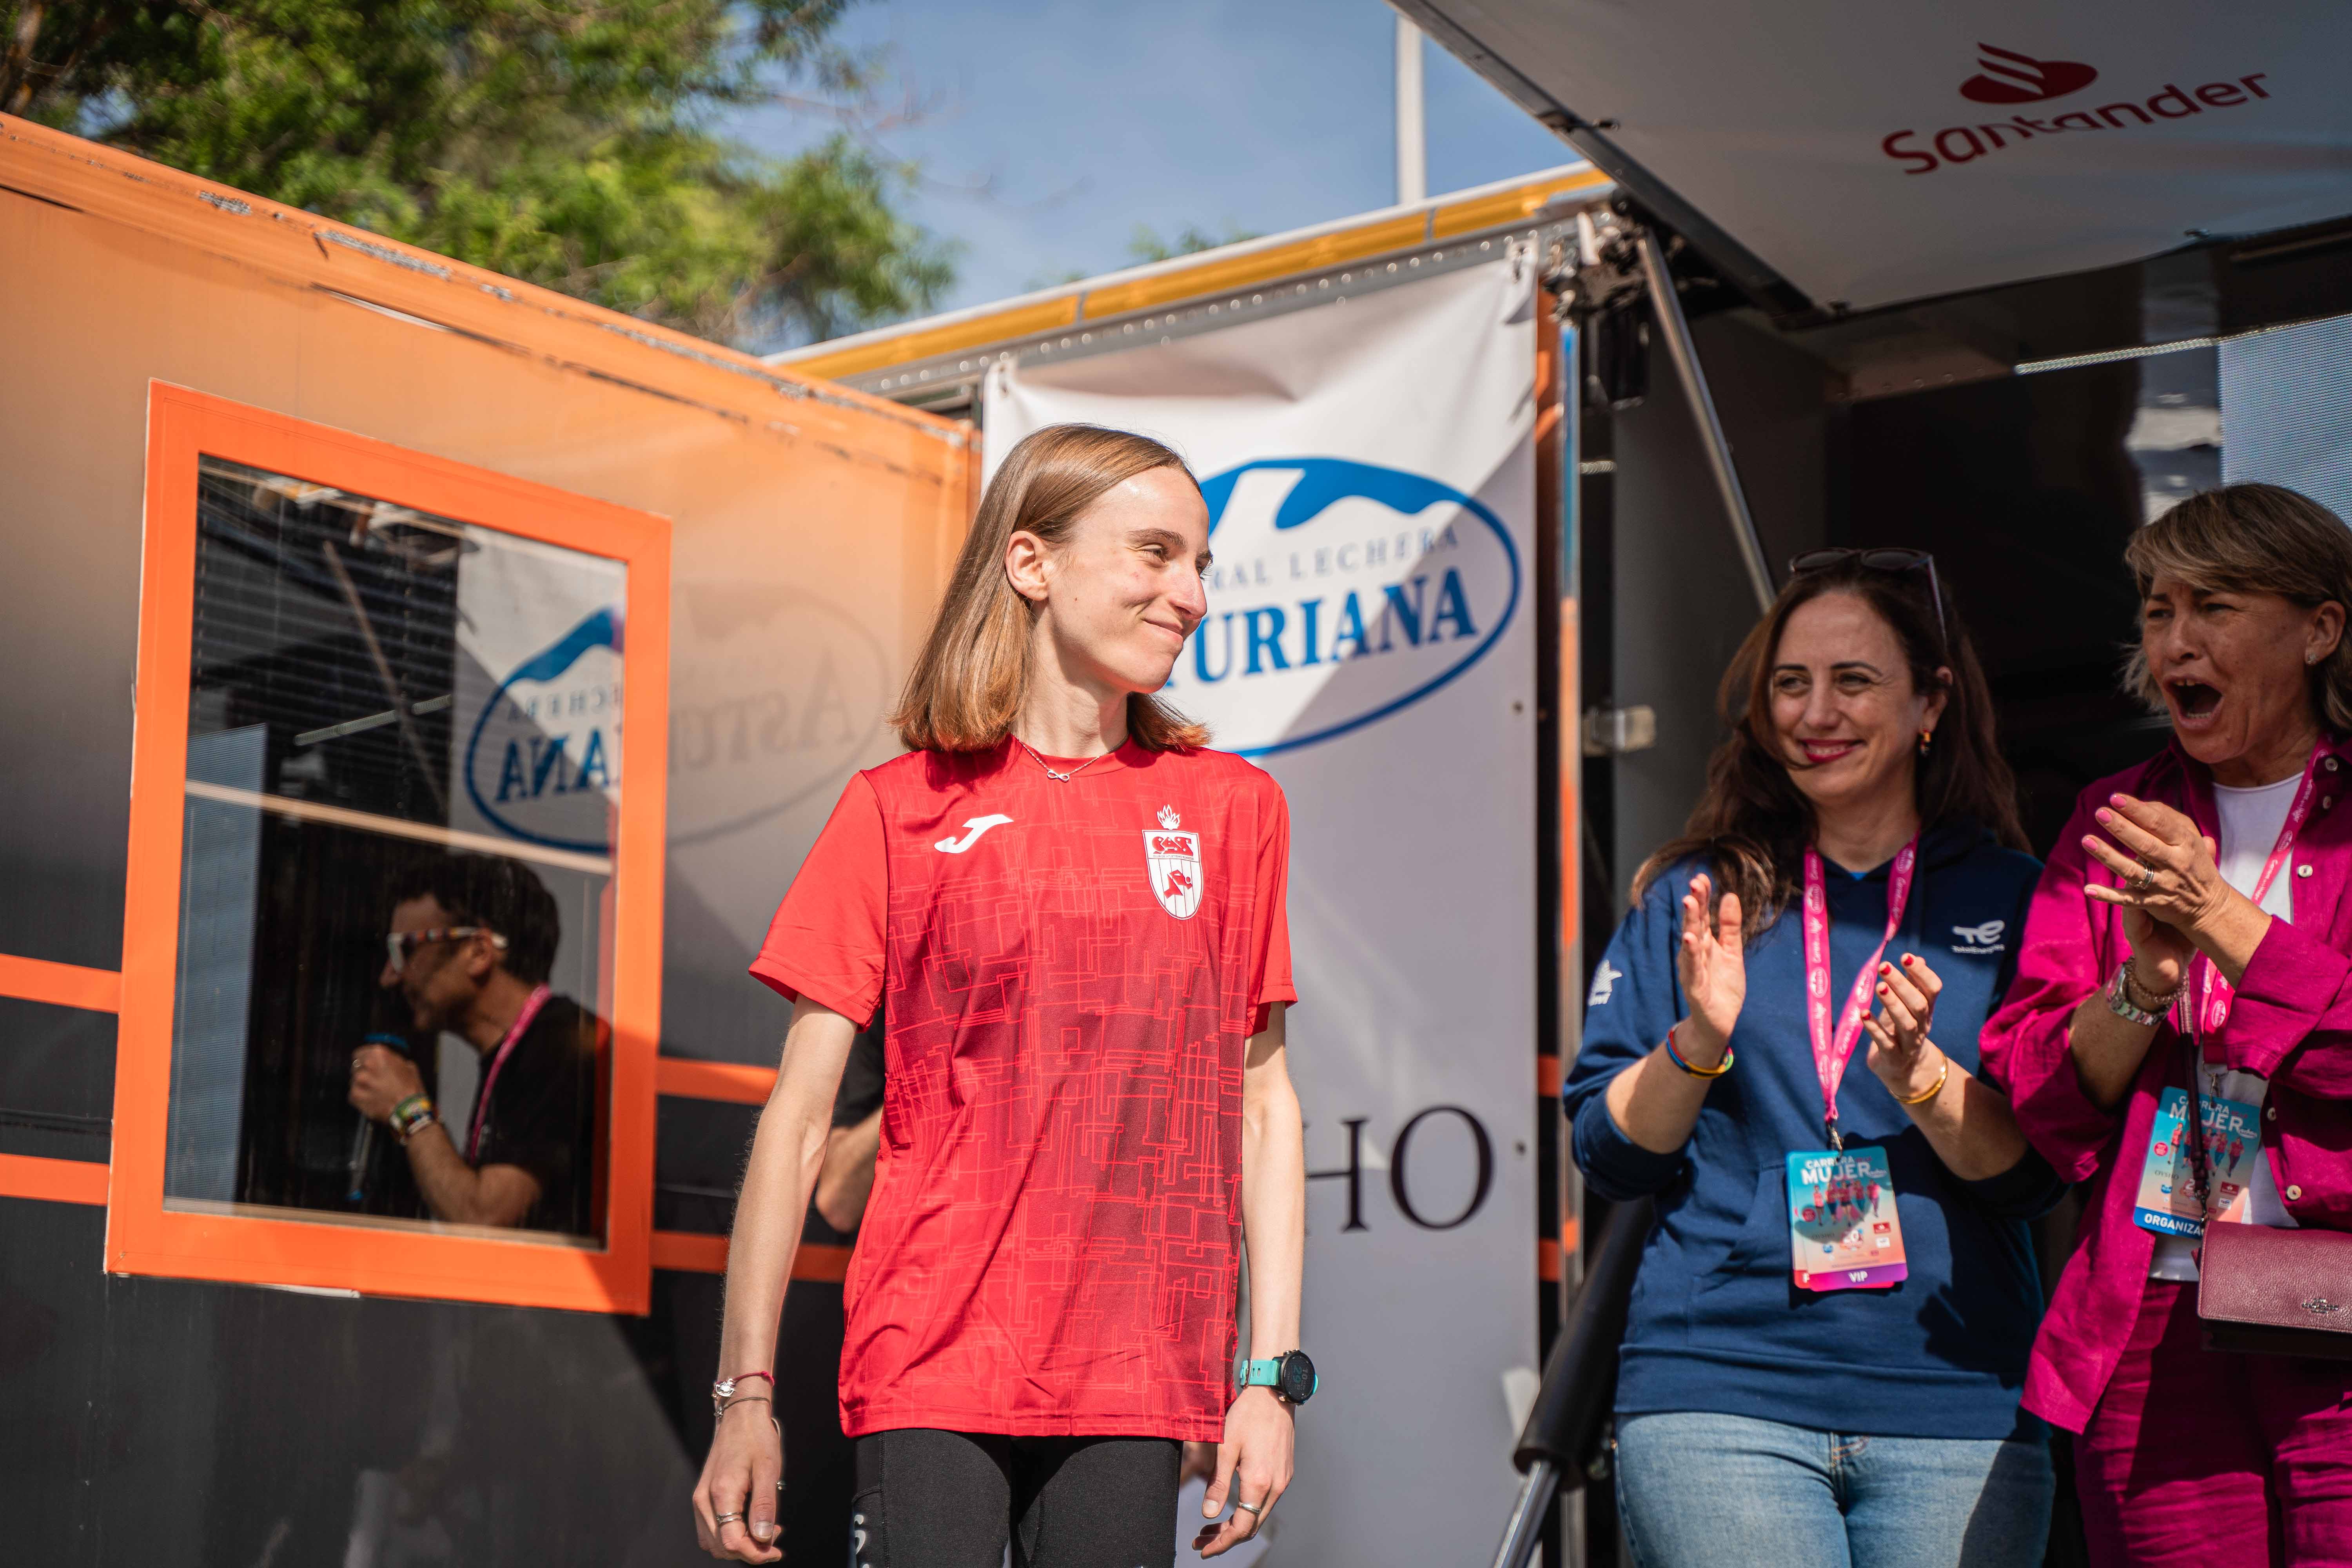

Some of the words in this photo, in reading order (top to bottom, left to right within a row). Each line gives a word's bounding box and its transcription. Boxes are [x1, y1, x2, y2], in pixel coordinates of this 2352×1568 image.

[1881, 73, 2272, 175] Santander
[1209, 557, 1272, 593] RAL
[1289, 523, 1459, 581] LECHERA
[1162, 564, 1479, 689] URIANA
[2169, 1102, 2245, 1132] MJER
[2179, 1096, 2230, 1114] CRRA
[1301, 1103, 1498, 1234] HO
[1800, 1161, 1870, 1185] MUJER
[1805, 1156, 1855, 1169] CARRRA
[2144, 1213, 2204, 1236] ORGANIZA
[1848, 1271, 1868, 1283] VIP
